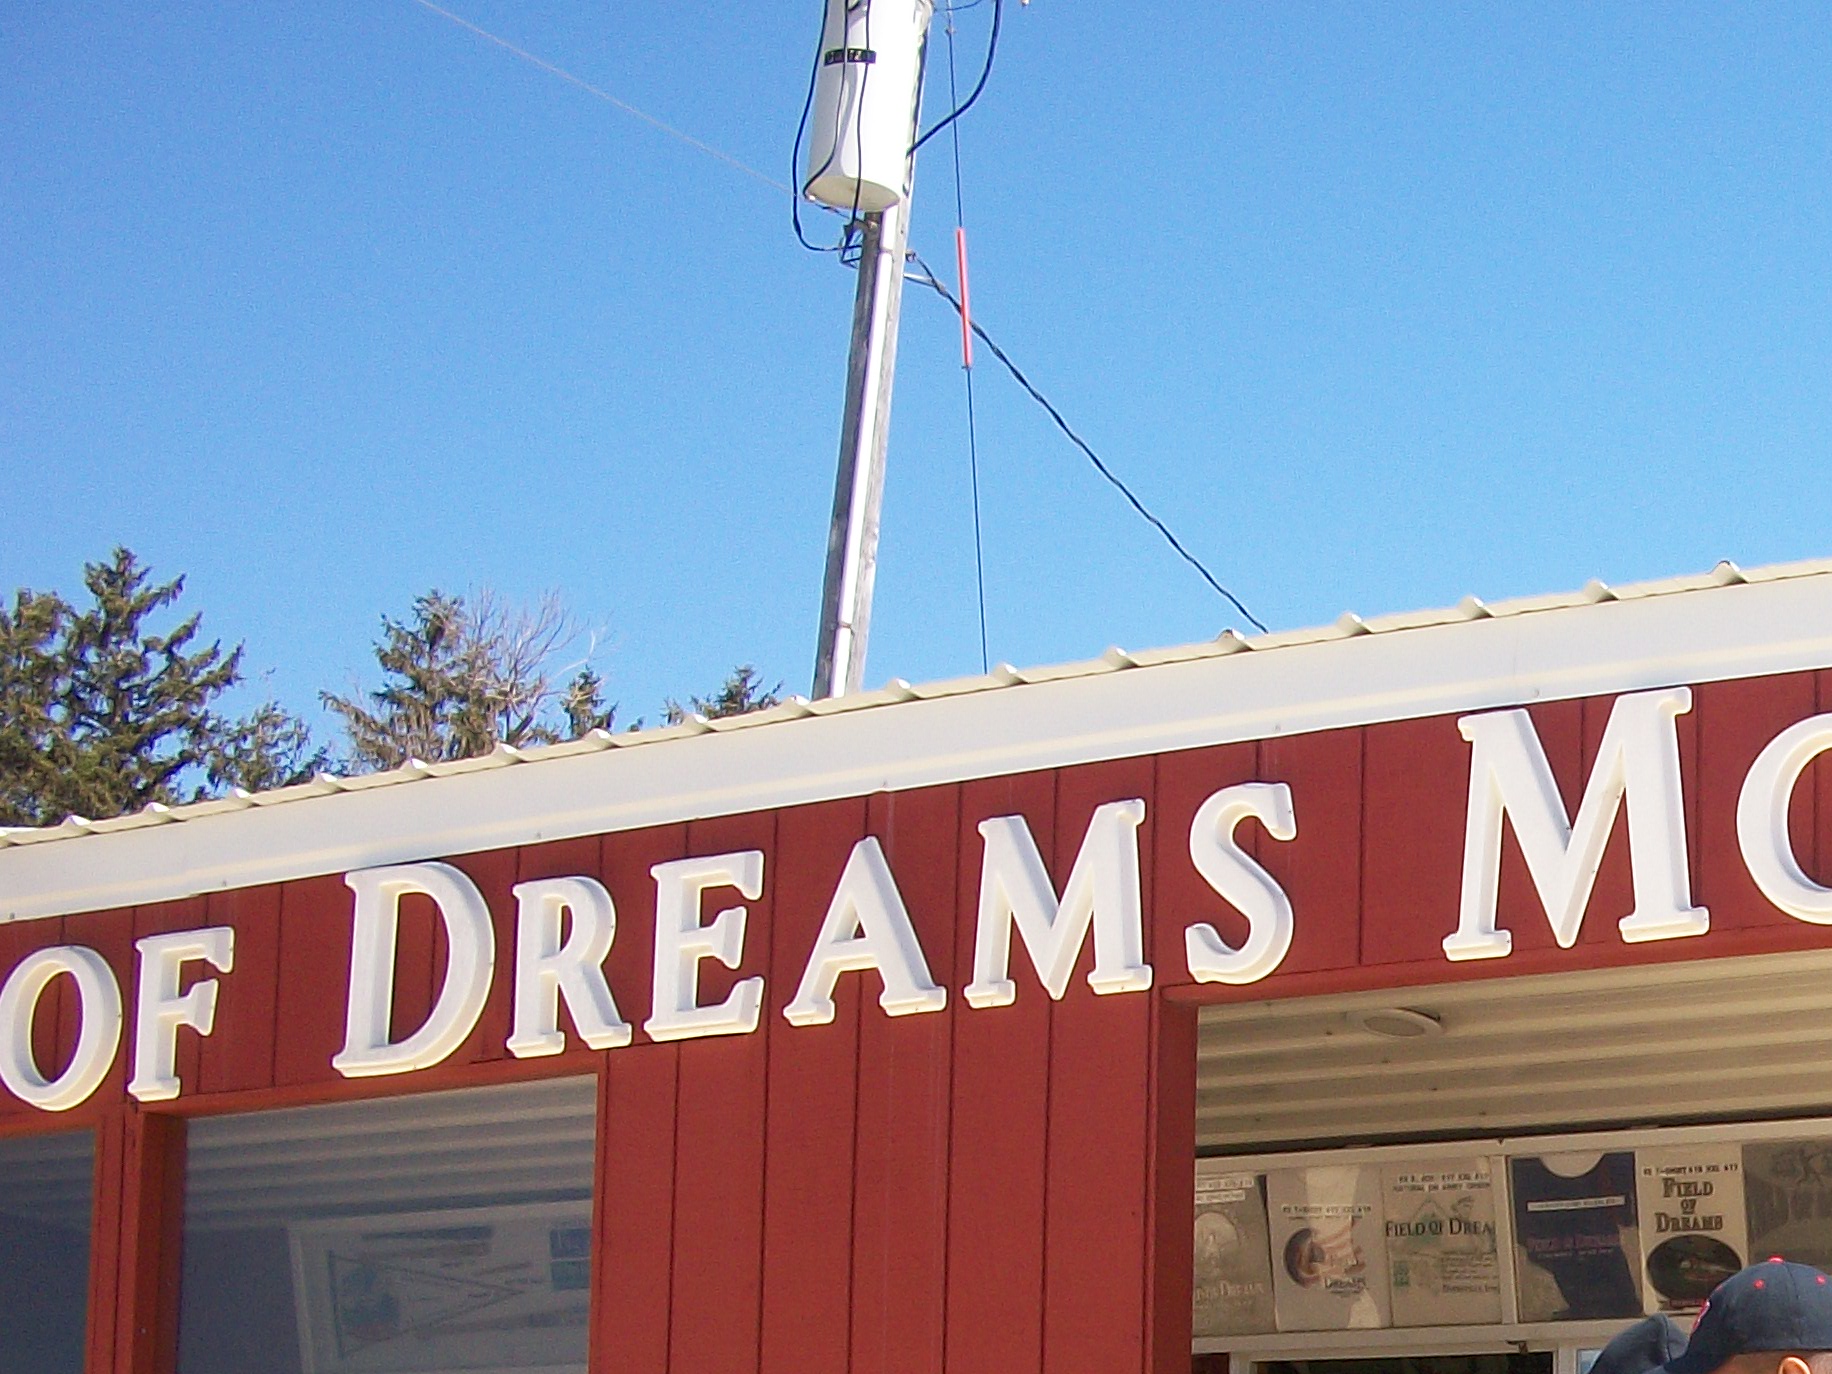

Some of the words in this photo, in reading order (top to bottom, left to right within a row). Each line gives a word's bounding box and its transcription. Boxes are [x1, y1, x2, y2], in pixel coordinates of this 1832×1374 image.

[0, 925, 235, 1111] OF
[332, 782, 1297, 1078] DREAMS
[1662, 1177, 1714, 1198] FIELD
[1385, 1220, 1426, 1237] FIELD
[1654, 1211, 1724, 1233] DREAMS
